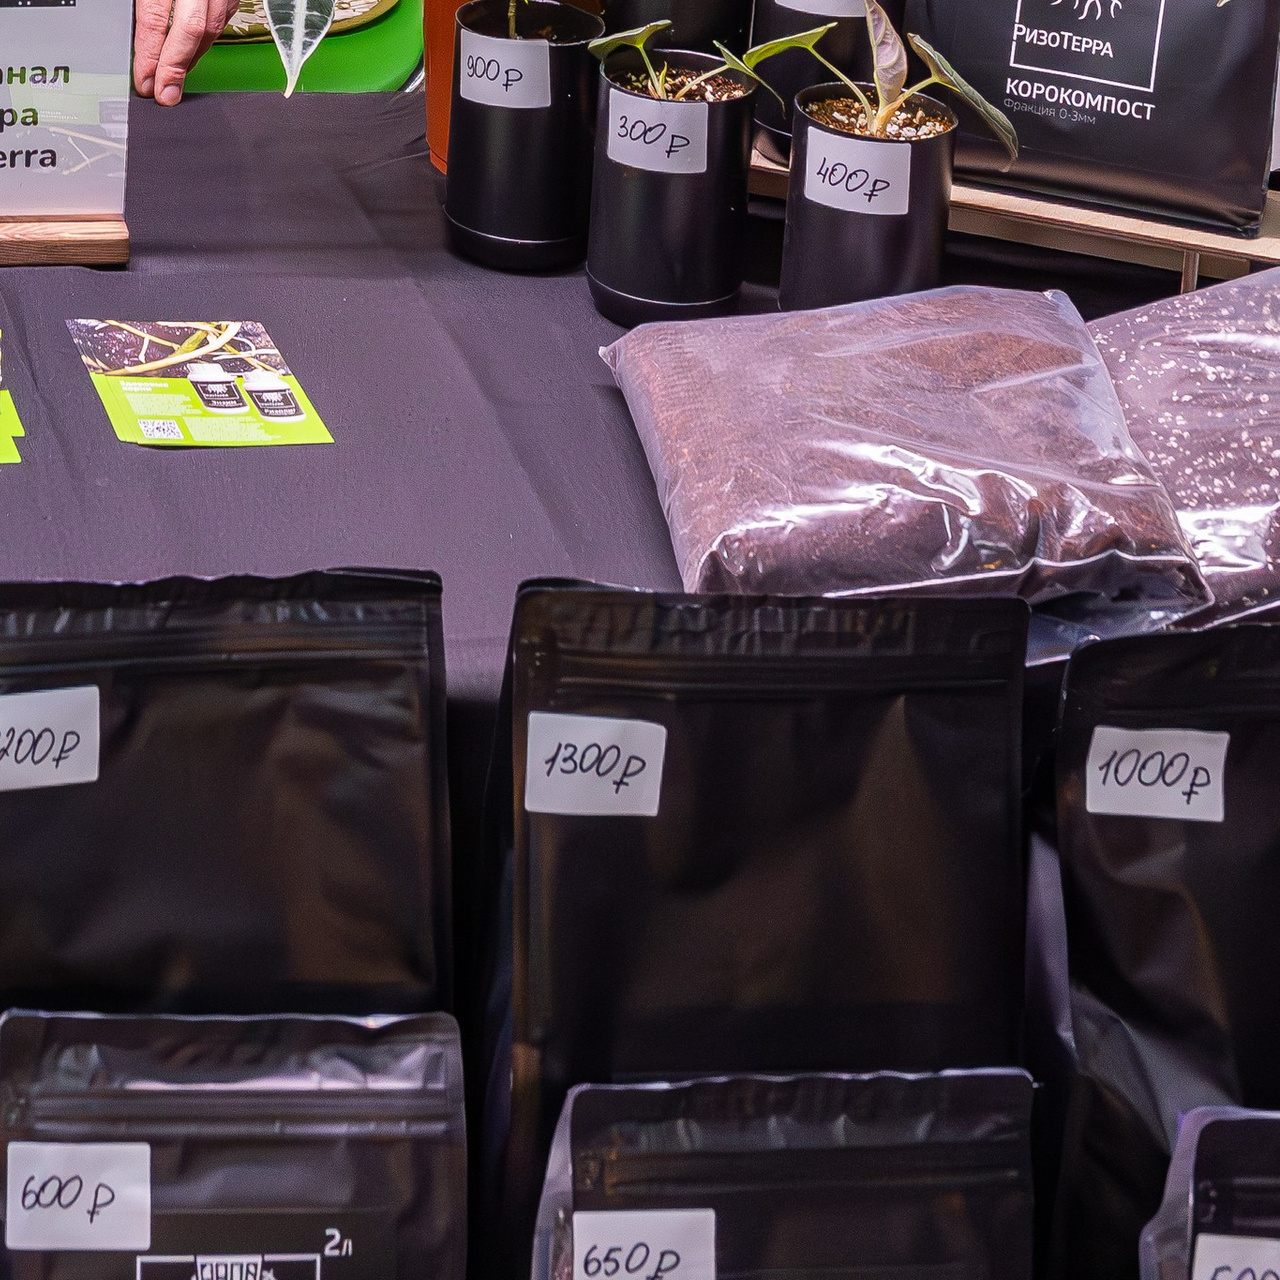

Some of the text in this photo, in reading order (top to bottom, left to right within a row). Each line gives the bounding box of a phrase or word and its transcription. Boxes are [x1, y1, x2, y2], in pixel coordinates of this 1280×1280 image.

[1003, 98, 1057, 119] Фракция
[1005, 77, 1156, 122] КОРОКОМПОСТ
[323, 1227, 354, 1257] 2л
